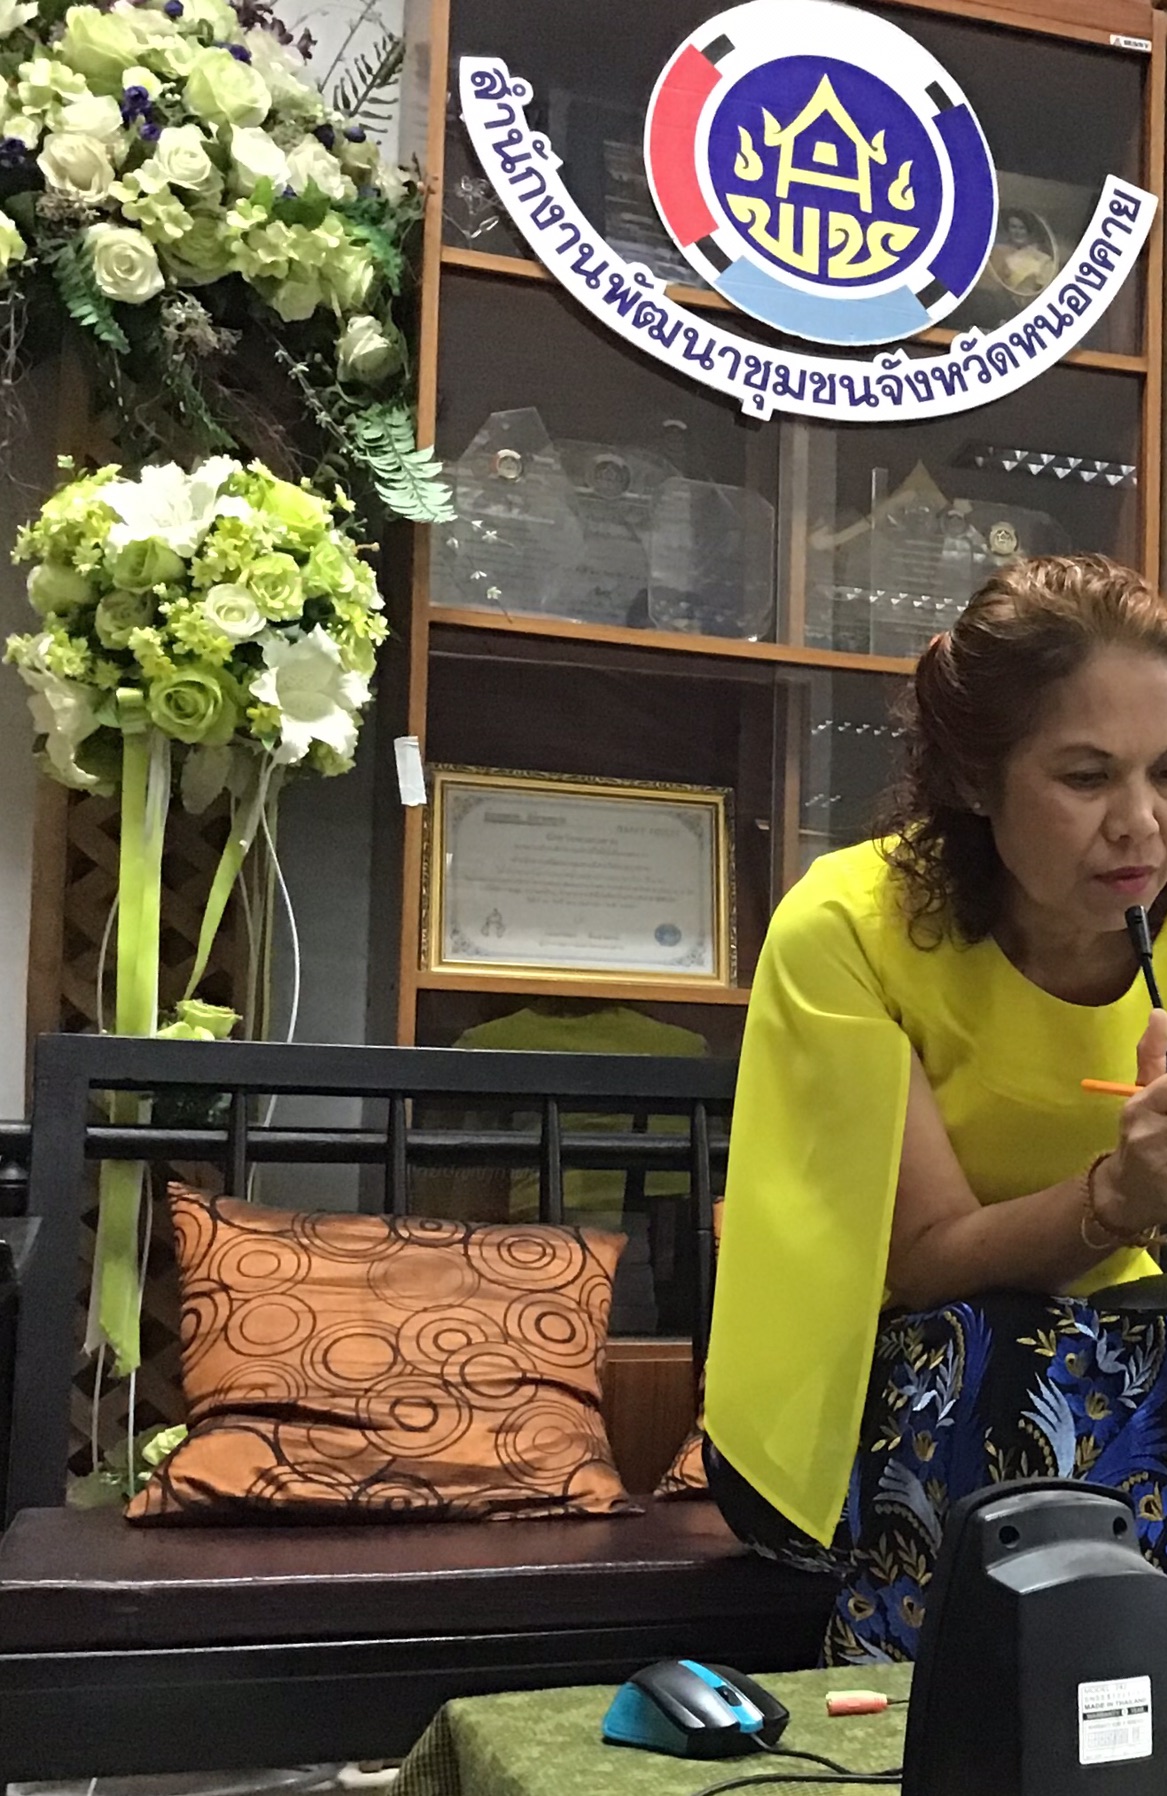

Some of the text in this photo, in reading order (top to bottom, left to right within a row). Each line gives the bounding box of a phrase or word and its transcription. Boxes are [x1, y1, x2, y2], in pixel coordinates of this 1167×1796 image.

[470, 67, 1142, 410] สำนักงานพัฒนาชุมชนจังหวัดหนองคาย
[1084, 1702, 1105, 1710] MADE
[1115, 1697, 1147, 1706] THAILAND
